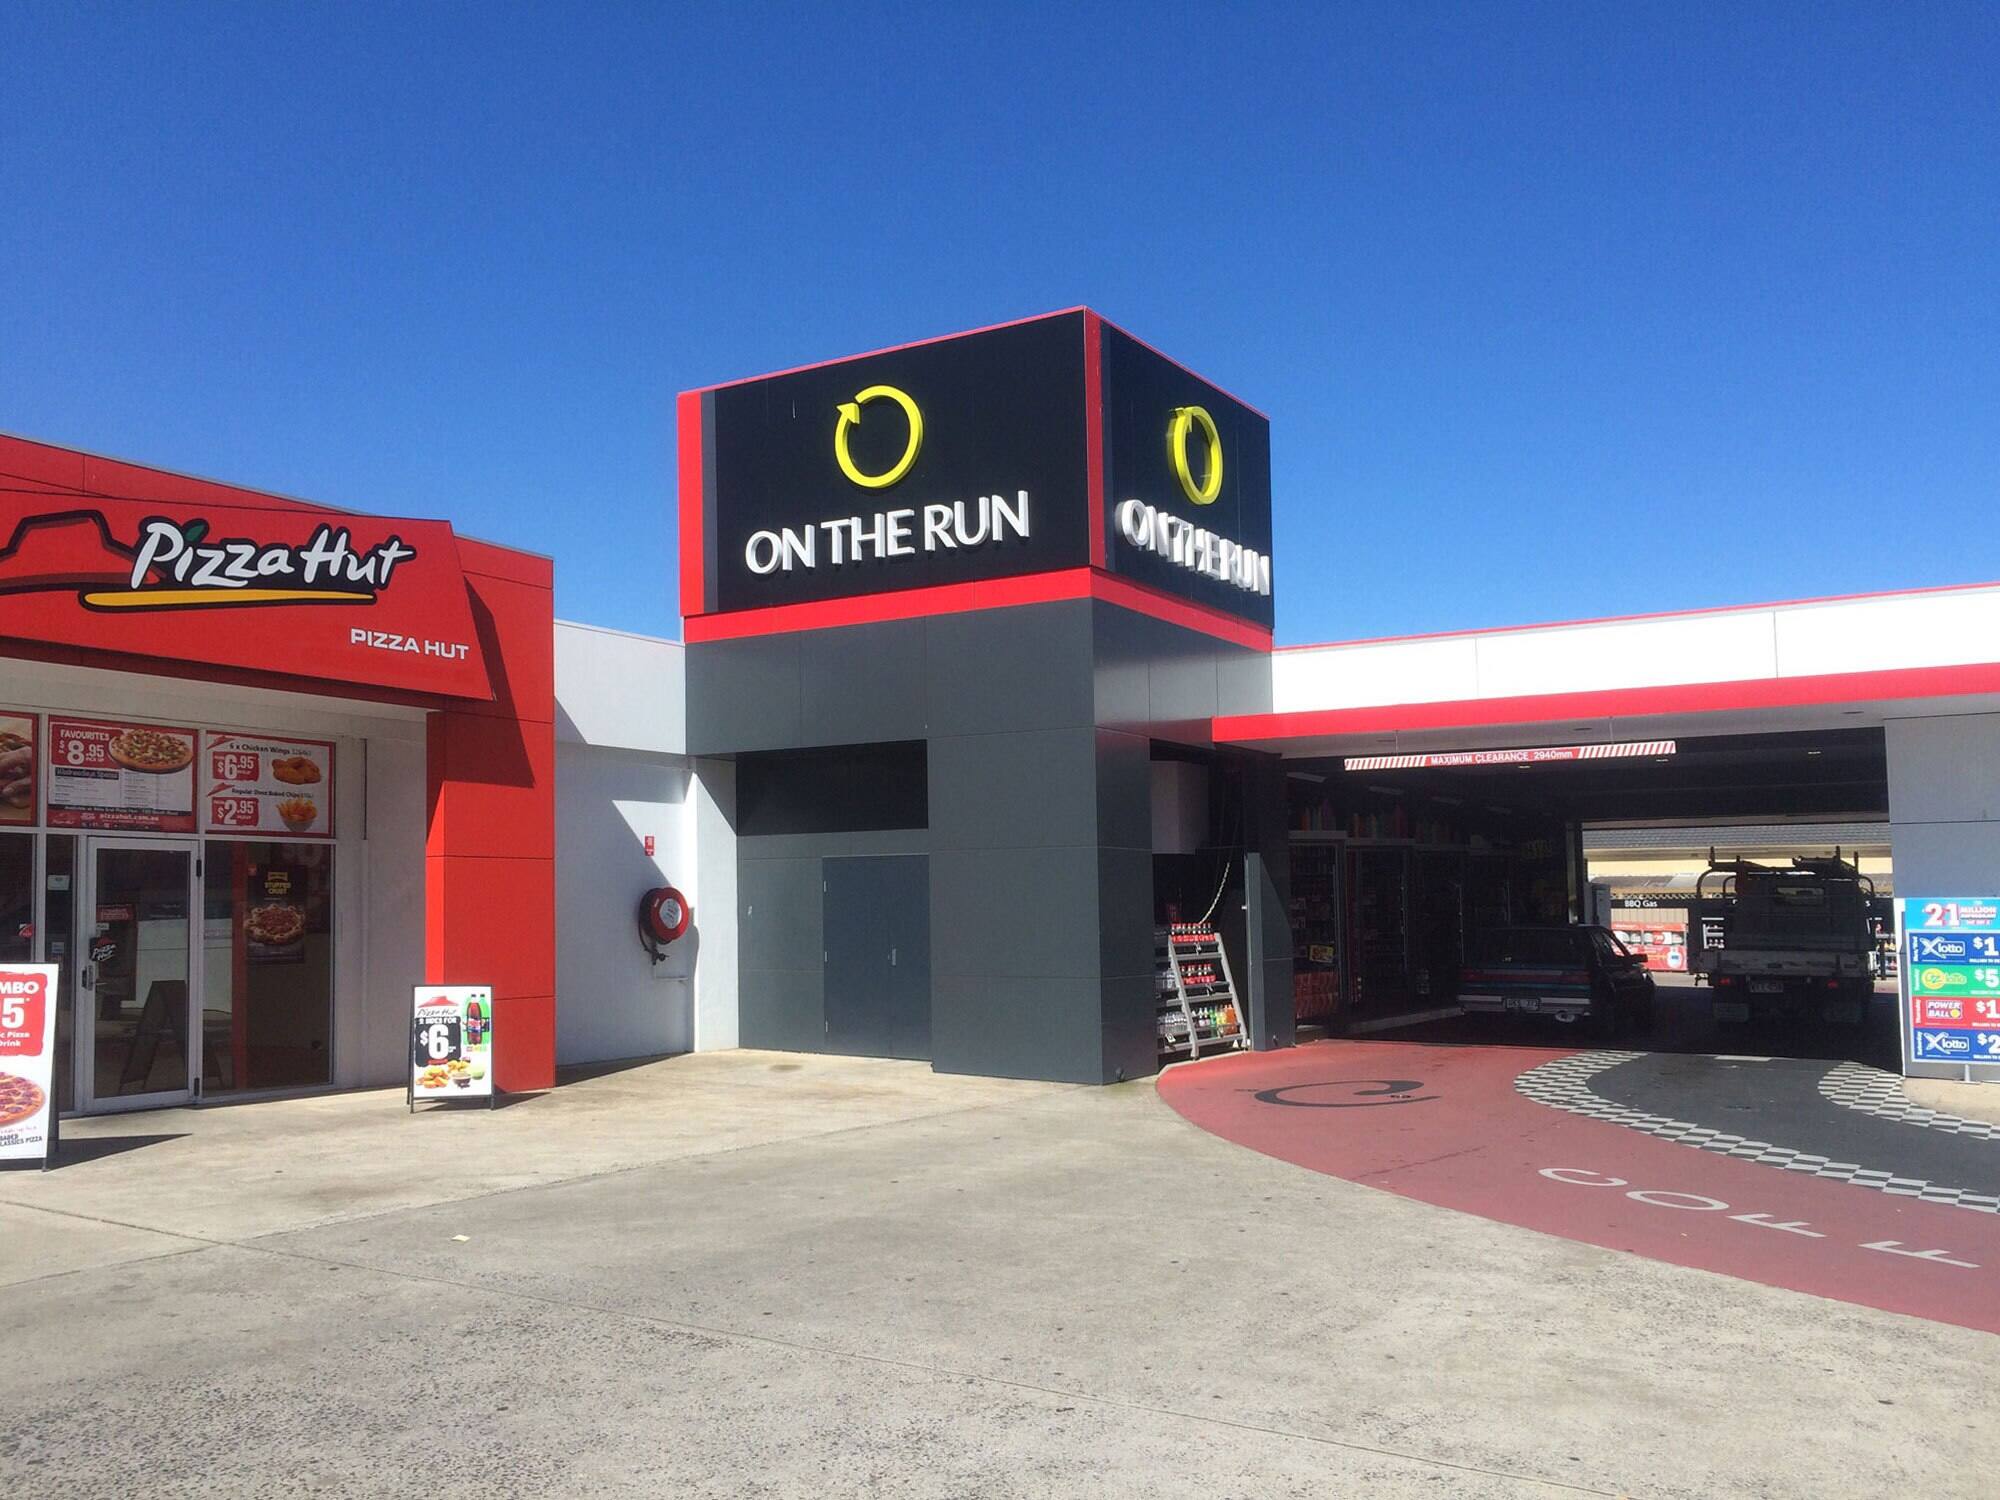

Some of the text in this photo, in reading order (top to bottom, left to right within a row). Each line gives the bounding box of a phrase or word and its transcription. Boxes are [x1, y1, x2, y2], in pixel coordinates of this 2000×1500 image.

[745, 490, 1030, 575] ON THE RUN
[131, 519, 415, 588] Pizza Hut
[1114, 498, 1270, 596] ON THE RUN
[350, 627, 469, 661] PIZZA HUT
[60, 729, 110, 742] FAVOURITES
[1431, 749, 1573, 765] MAXIMUM CLEARANCE 2940mm
[1624, 900, 1658, 908] BBQ Gas
[1927, 1001, 1961, 1009] POWER
[1927, 1010, 1951, 1018] BALL
